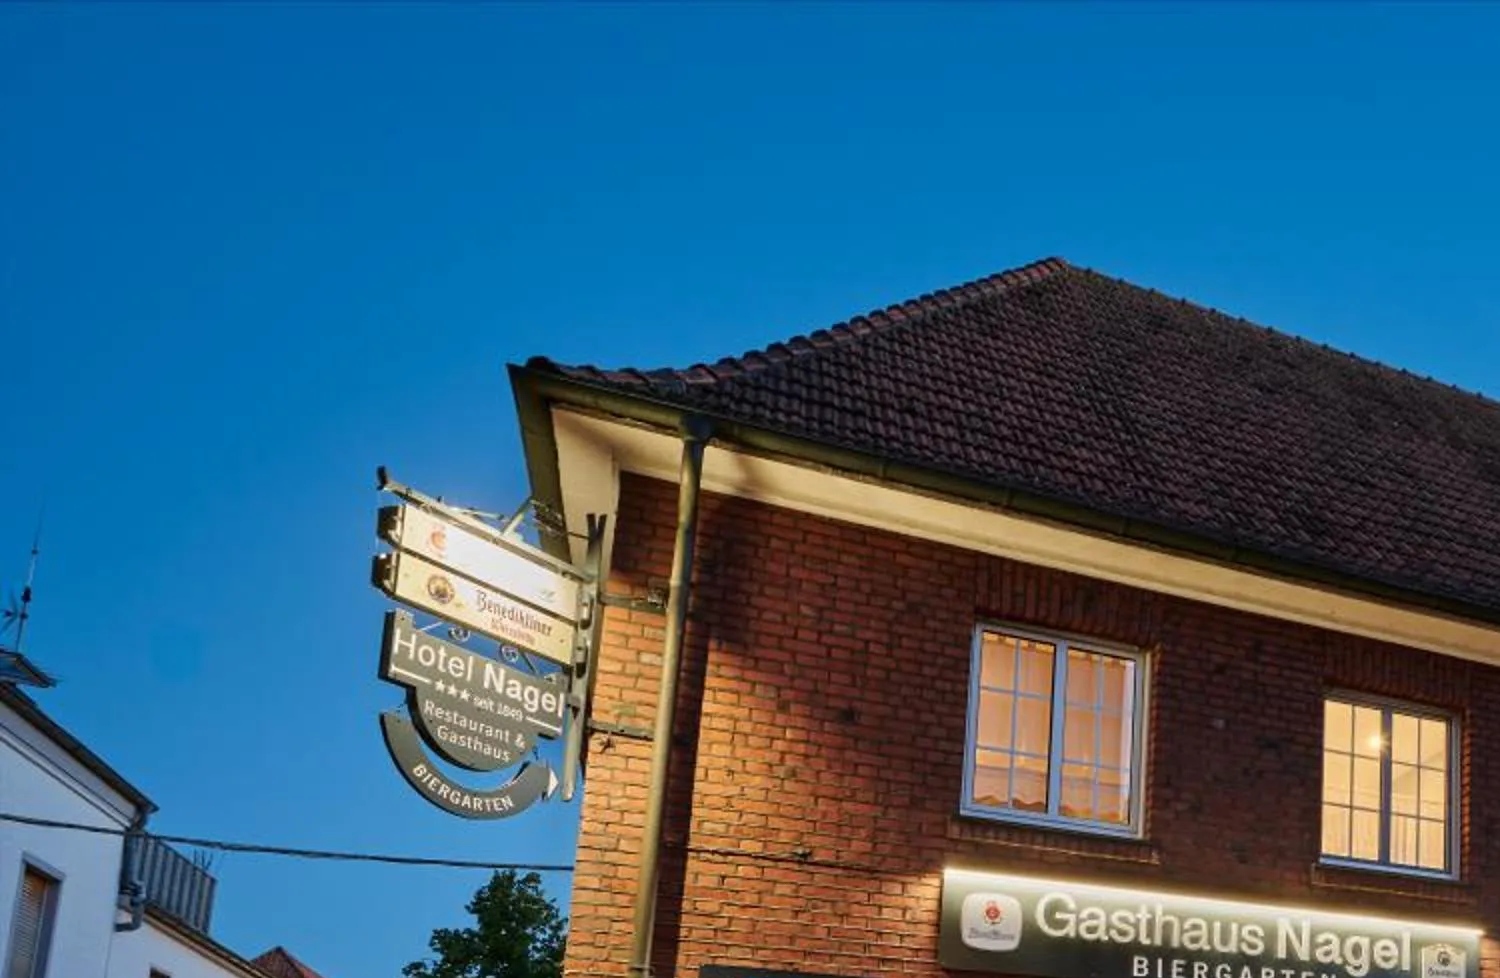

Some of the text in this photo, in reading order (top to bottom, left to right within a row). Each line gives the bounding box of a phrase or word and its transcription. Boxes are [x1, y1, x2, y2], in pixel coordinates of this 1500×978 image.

[392, 628, 474, 682] Hotel
[482, 663, 566, 718] Nagel
[423, 699, 527, 750] Restaurant &
[436, 725, 511, 763] Gasthaus
[412, 763, 515, 813] BIERGARTEN
[1034, 891, 1412, 978] Gasthaus Nagel
